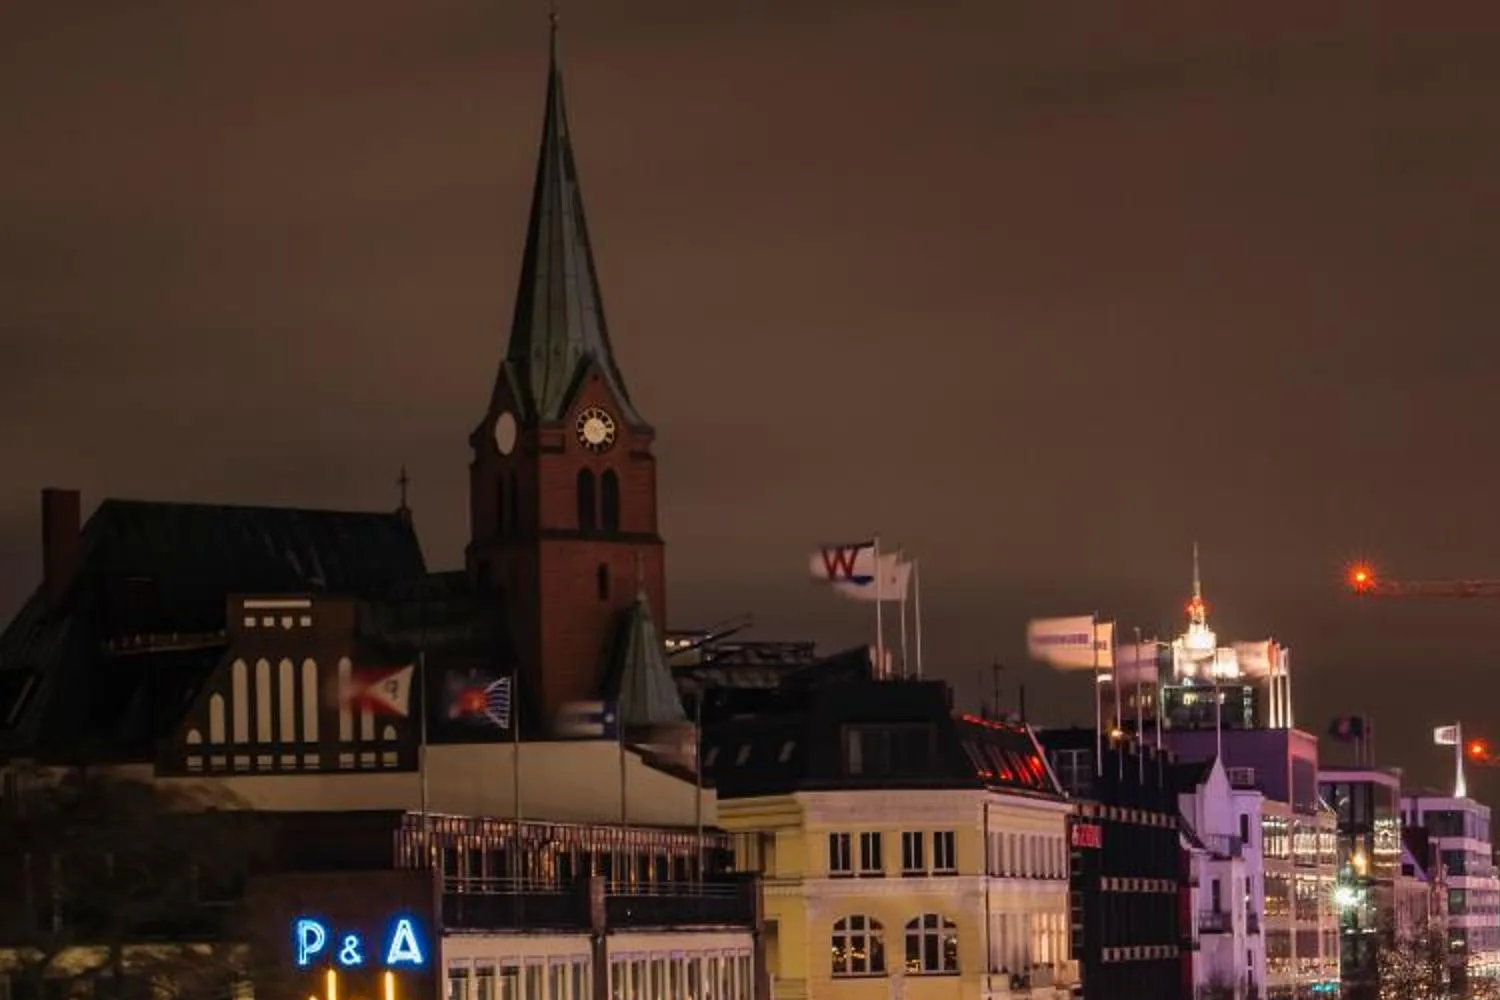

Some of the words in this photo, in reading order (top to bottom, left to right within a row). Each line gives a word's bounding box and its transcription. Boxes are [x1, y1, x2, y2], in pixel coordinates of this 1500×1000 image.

[821, 545, 859, 580] W
[298, 919, 325, 965] P
[339, 934, 363, 966] &
[387, 918, 424, 965] A
